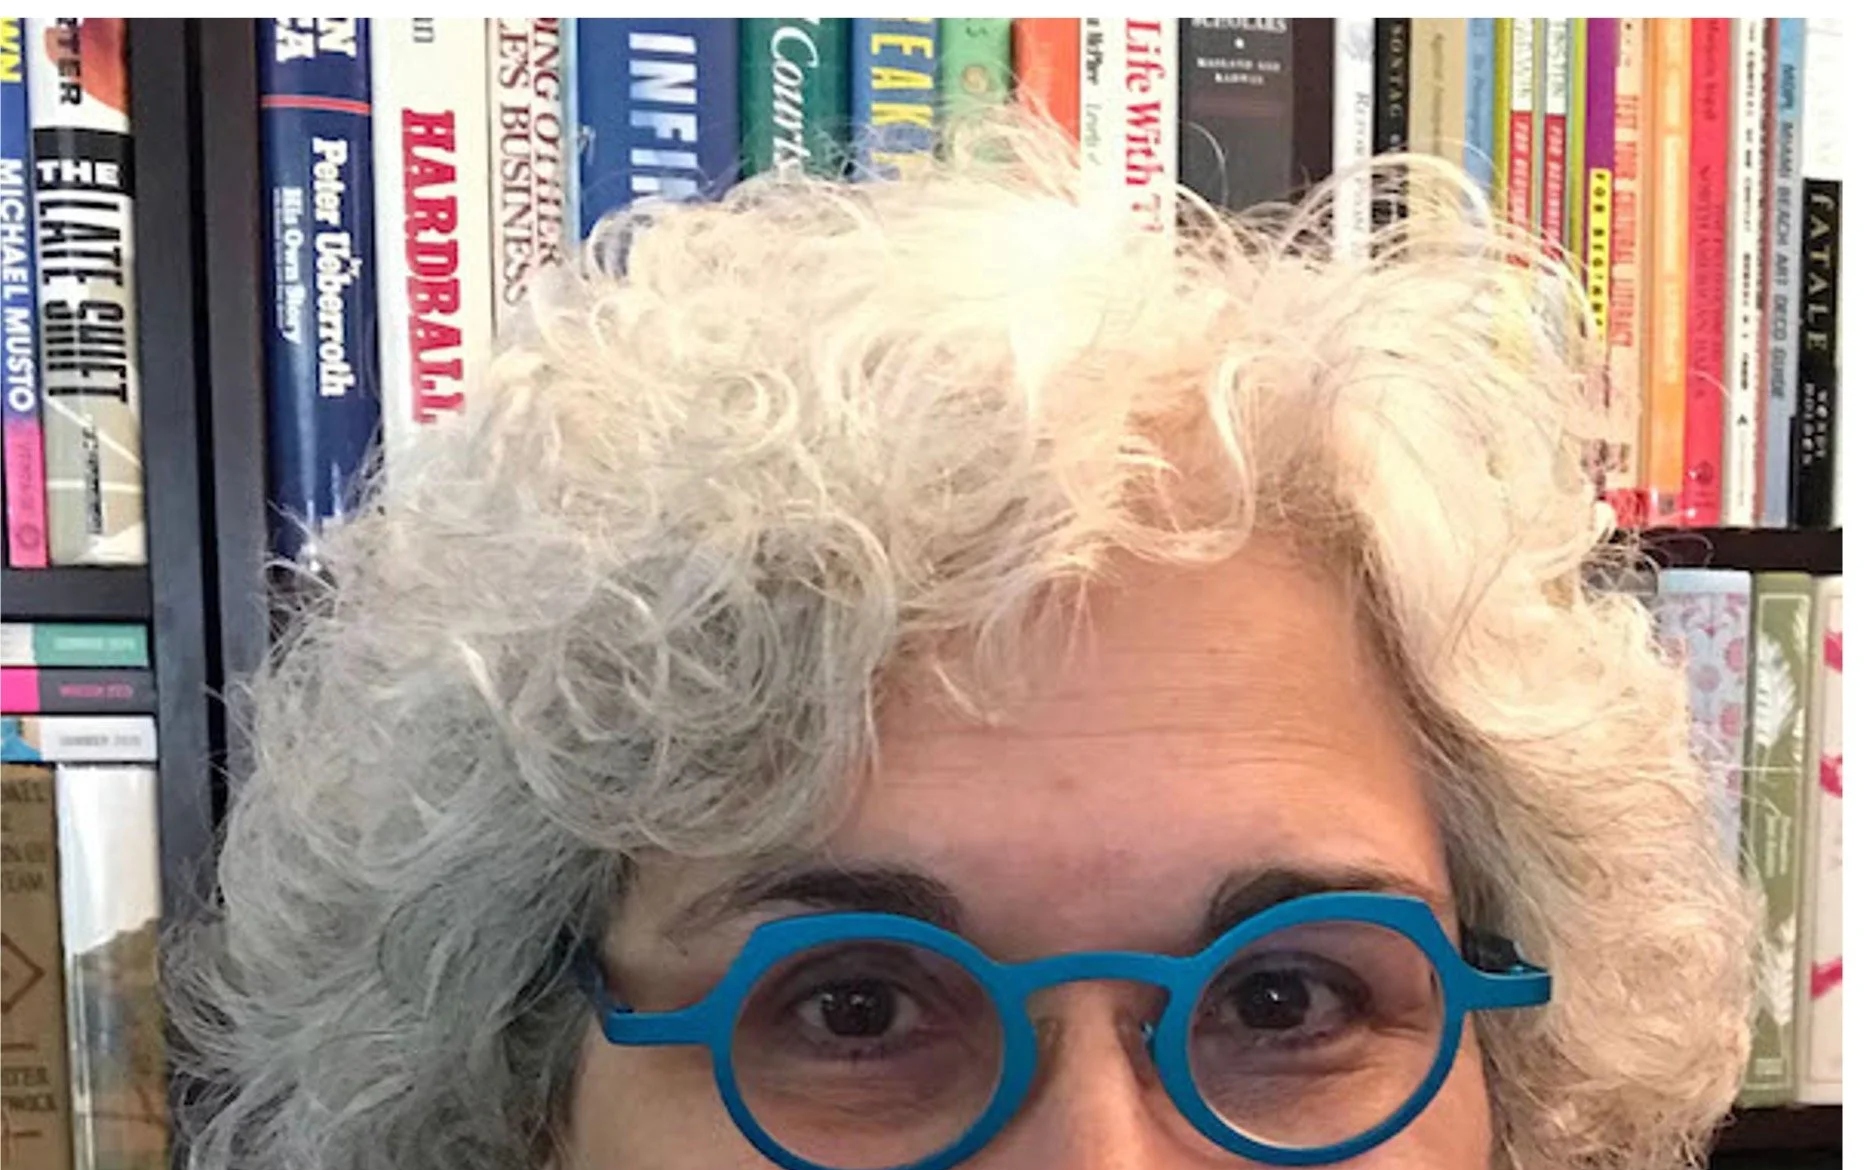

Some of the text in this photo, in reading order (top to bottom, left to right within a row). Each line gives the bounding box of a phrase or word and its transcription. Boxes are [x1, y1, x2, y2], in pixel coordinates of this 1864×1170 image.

[1125, 19, 1167, 93] Life
[36, 160, 119, 185] THE
[500, 102, 532, 308] BUSINESS
[535, 111, 563, 268] OTHER
[1125, 101, 1165, 186] With
[1776, 185, 1793, 246] BEACH
[1778, 121, 1796, 178] MIAMI
[0, 157, 36, 411] MICHAEL MUSTO
[38, 200, 128, 405] LATE SHIFT
[279, 186, 307, 345] His Own Story
[312, 137, 357, 397] Peter Ueberroth
[401, 108, 466, 425] HARDBALL
[1773, 294, 1790, 341] DECO
